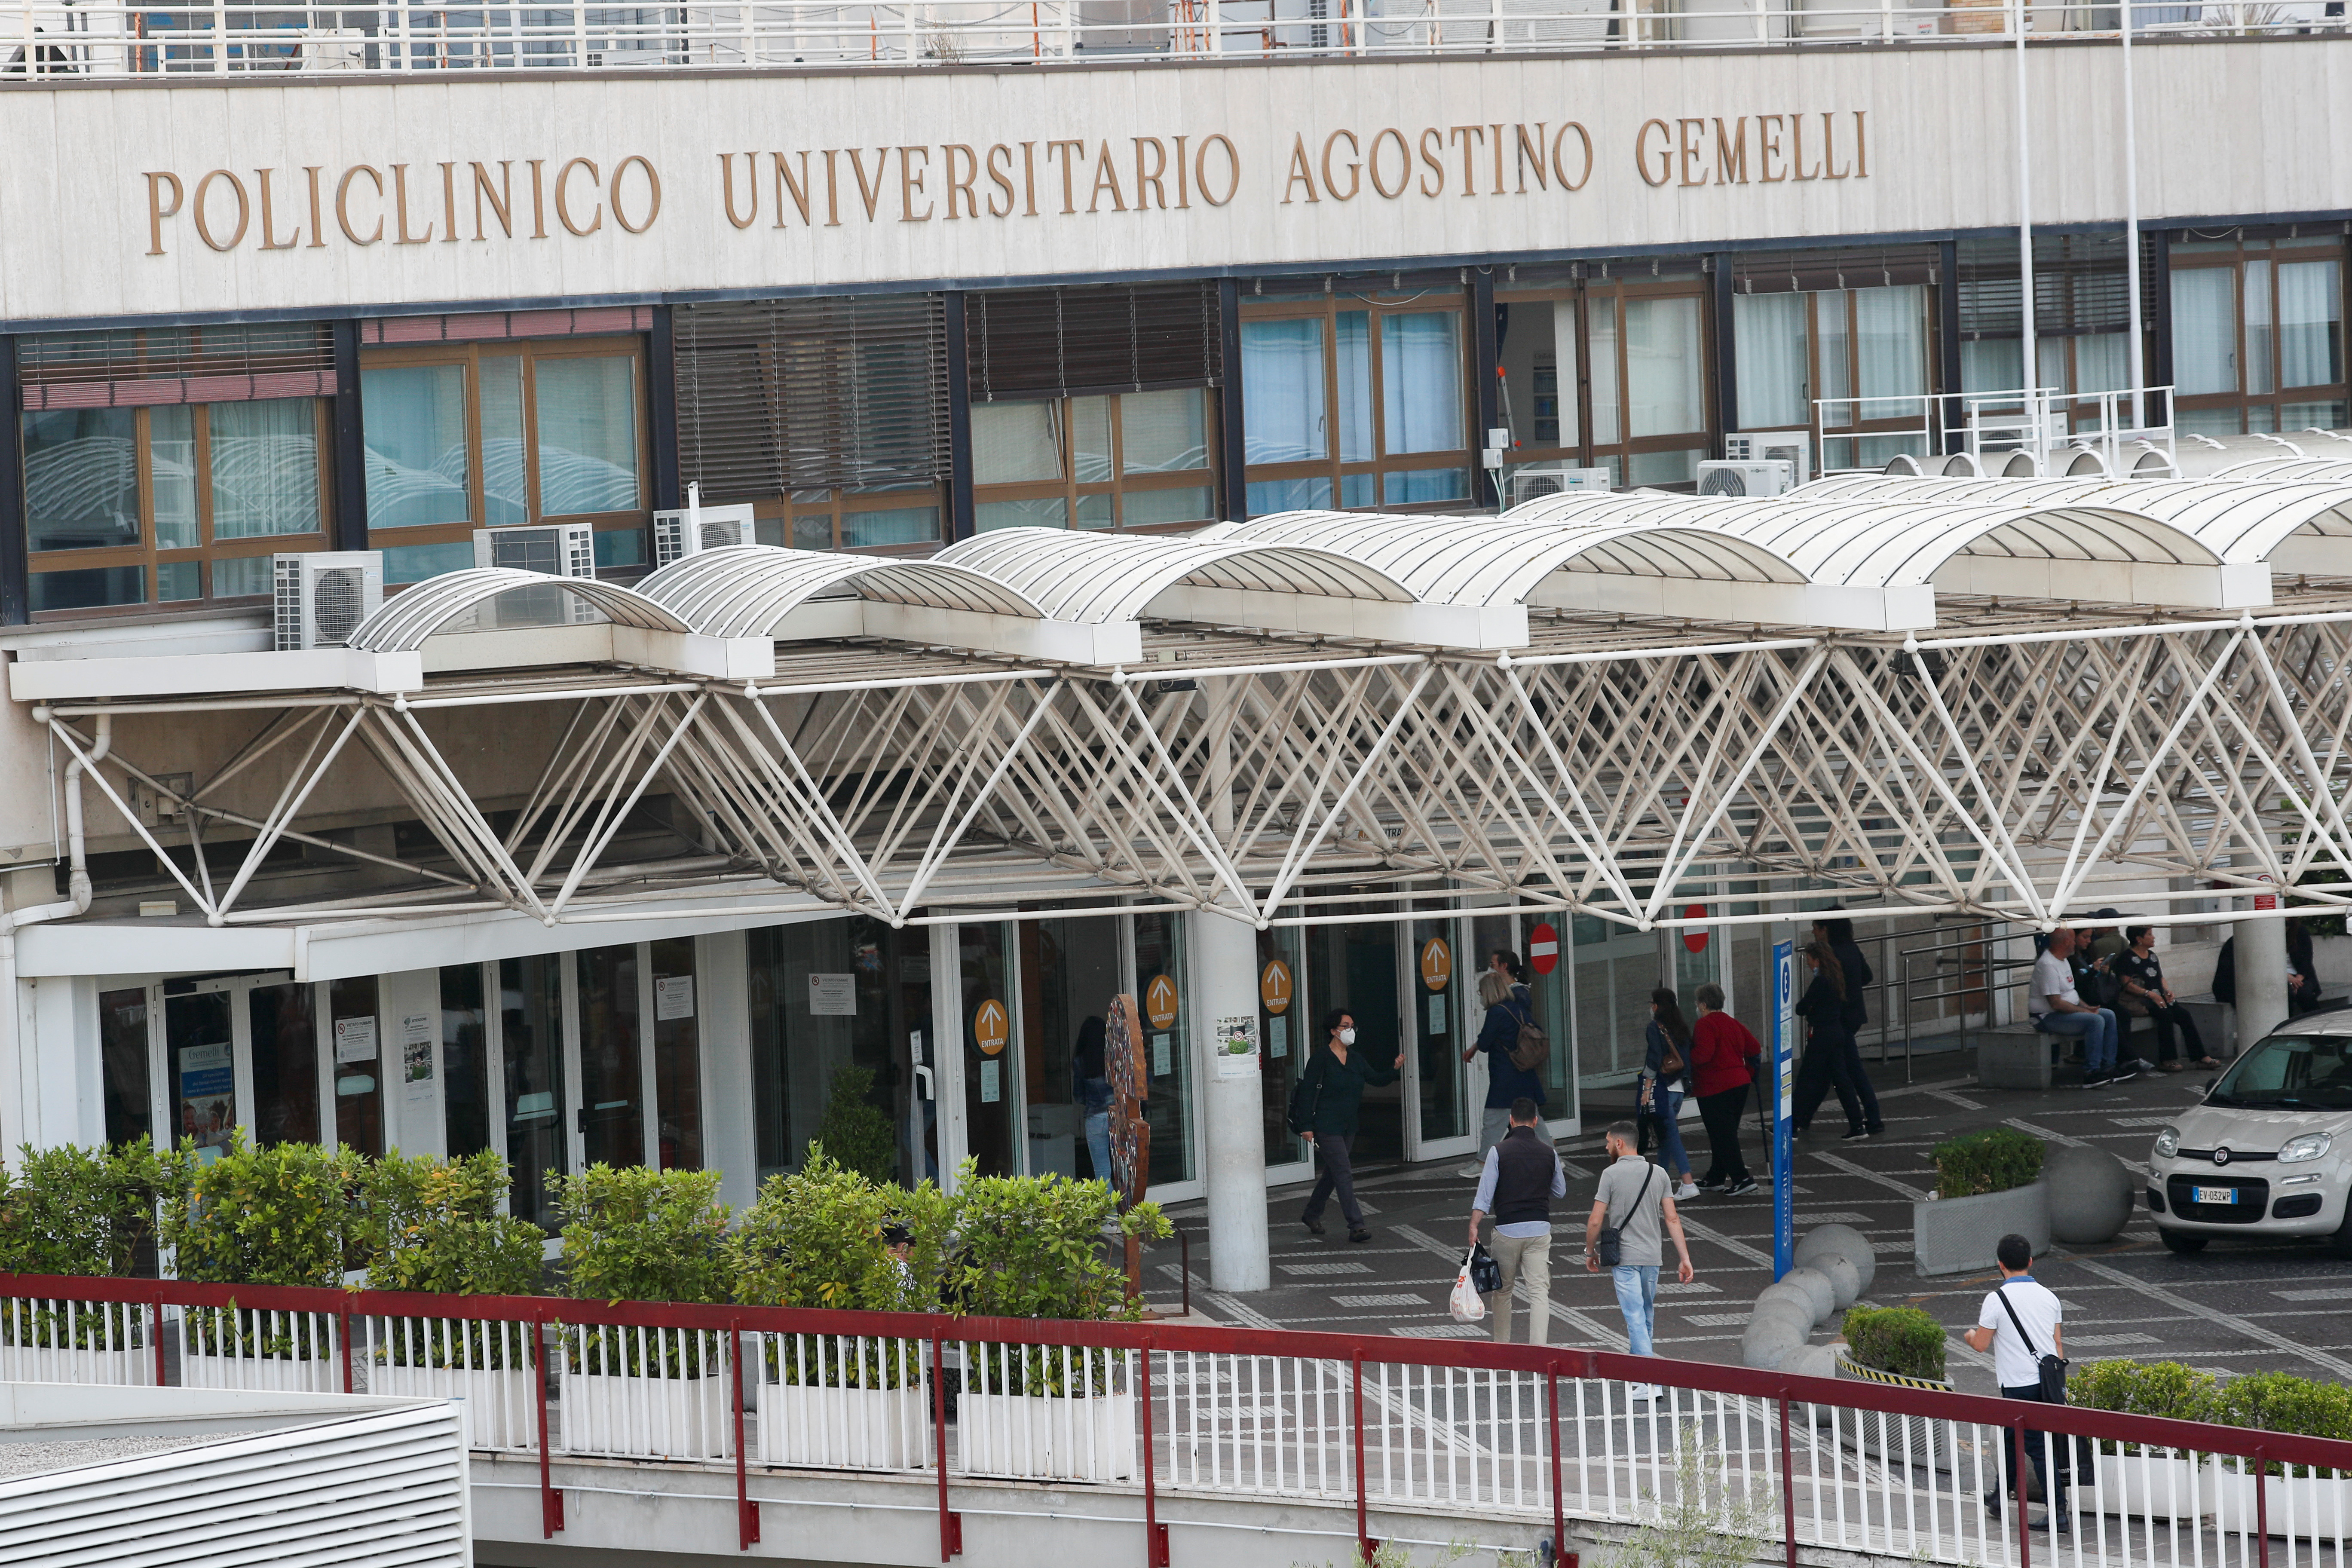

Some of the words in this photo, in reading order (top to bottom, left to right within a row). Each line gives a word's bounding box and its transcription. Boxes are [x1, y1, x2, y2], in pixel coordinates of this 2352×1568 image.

[143, 156, 662, 255] POLICLINICO
[718, 134, 1240, 230] UNIVERSITARIO
[1282, 121, 1593, 203] AGOSTINO
[1635, 110, 1868, 188] GEMELLI
[1427, 974, 1447, 983] ENTRATA
[1785, 971, 1788, 993] E
[1267, 997, 1288, 1006] ENTRATA
[1152, 1013, 1173, 1023] ENTRATA
[981, 1038, 1004, 1048] ENTRATA
[189, 1046, 219, 1060] Gemelli
